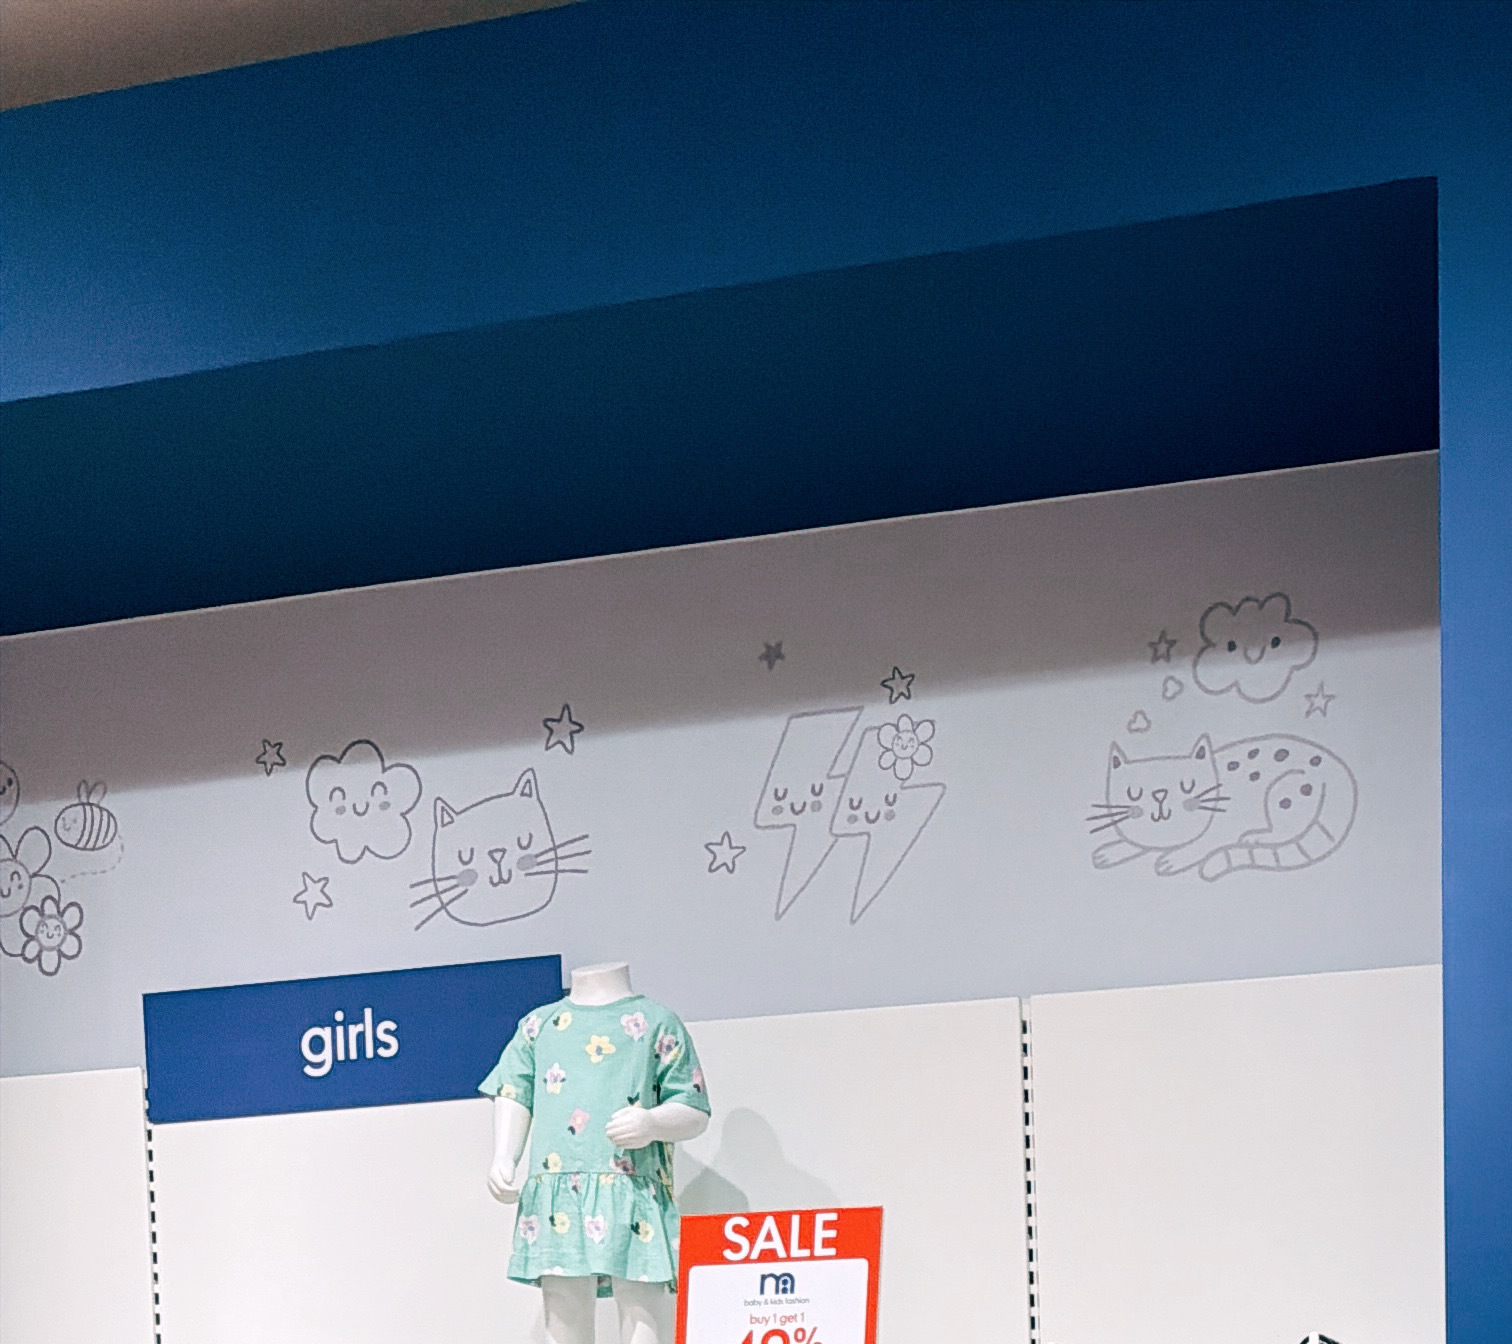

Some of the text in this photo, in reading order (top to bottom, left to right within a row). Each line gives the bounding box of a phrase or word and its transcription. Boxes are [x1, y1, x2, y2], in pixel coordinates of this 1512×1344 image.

[300, 1007, 399, 1077] girls
[722, 1212, 838, 1261] SALE
[749, 1313, 771, 1326] buy
[779, 1313, 798, 1326] get
[800, 1312, 805, 1322] 1
